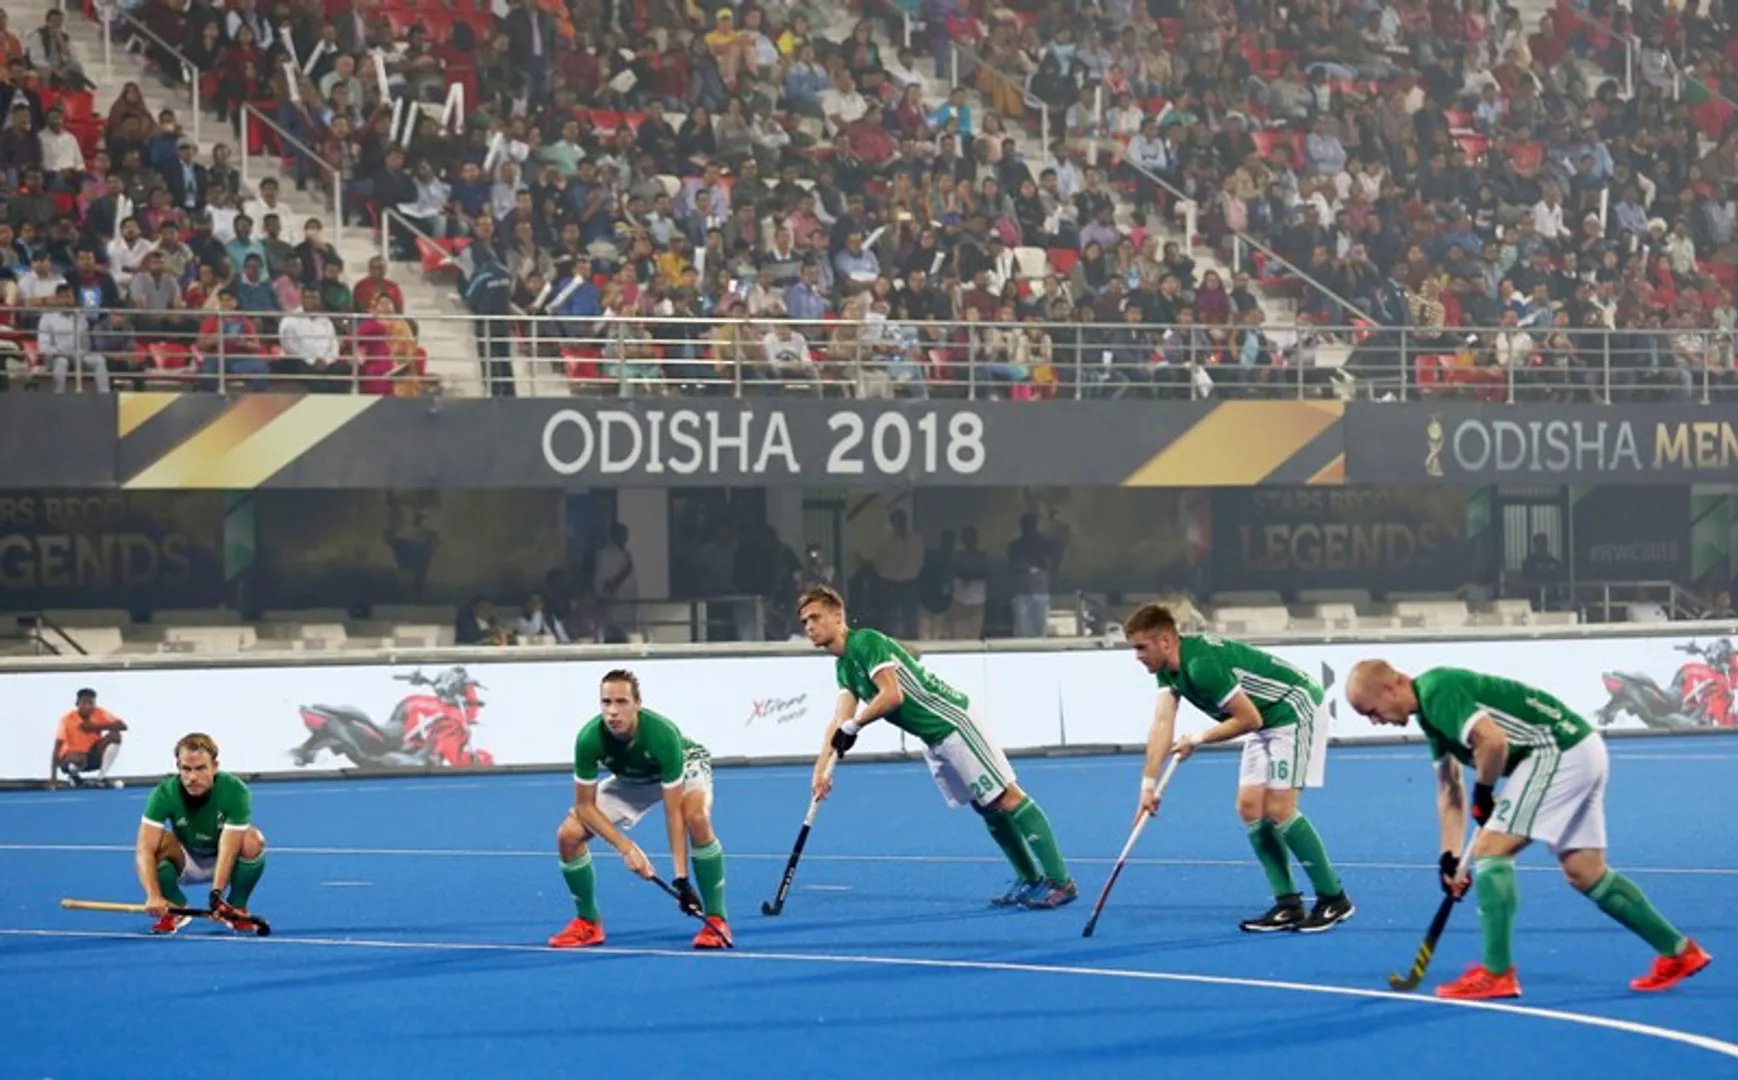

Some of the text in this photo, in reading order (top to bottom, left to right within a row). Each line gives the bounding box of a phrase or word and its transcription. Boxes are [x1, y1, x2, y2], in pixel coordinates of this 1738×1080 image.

[542, 410, 986, 474] ODISHA 2018
[1453, 419, 1642, 471] ODISHA
[0, 533, 192, 588] GENDS
[1237, 522, 1438, 571] LEGENDS
[970, 774, 994, 798] 29
[1268, 760, 1288, 780] 16
